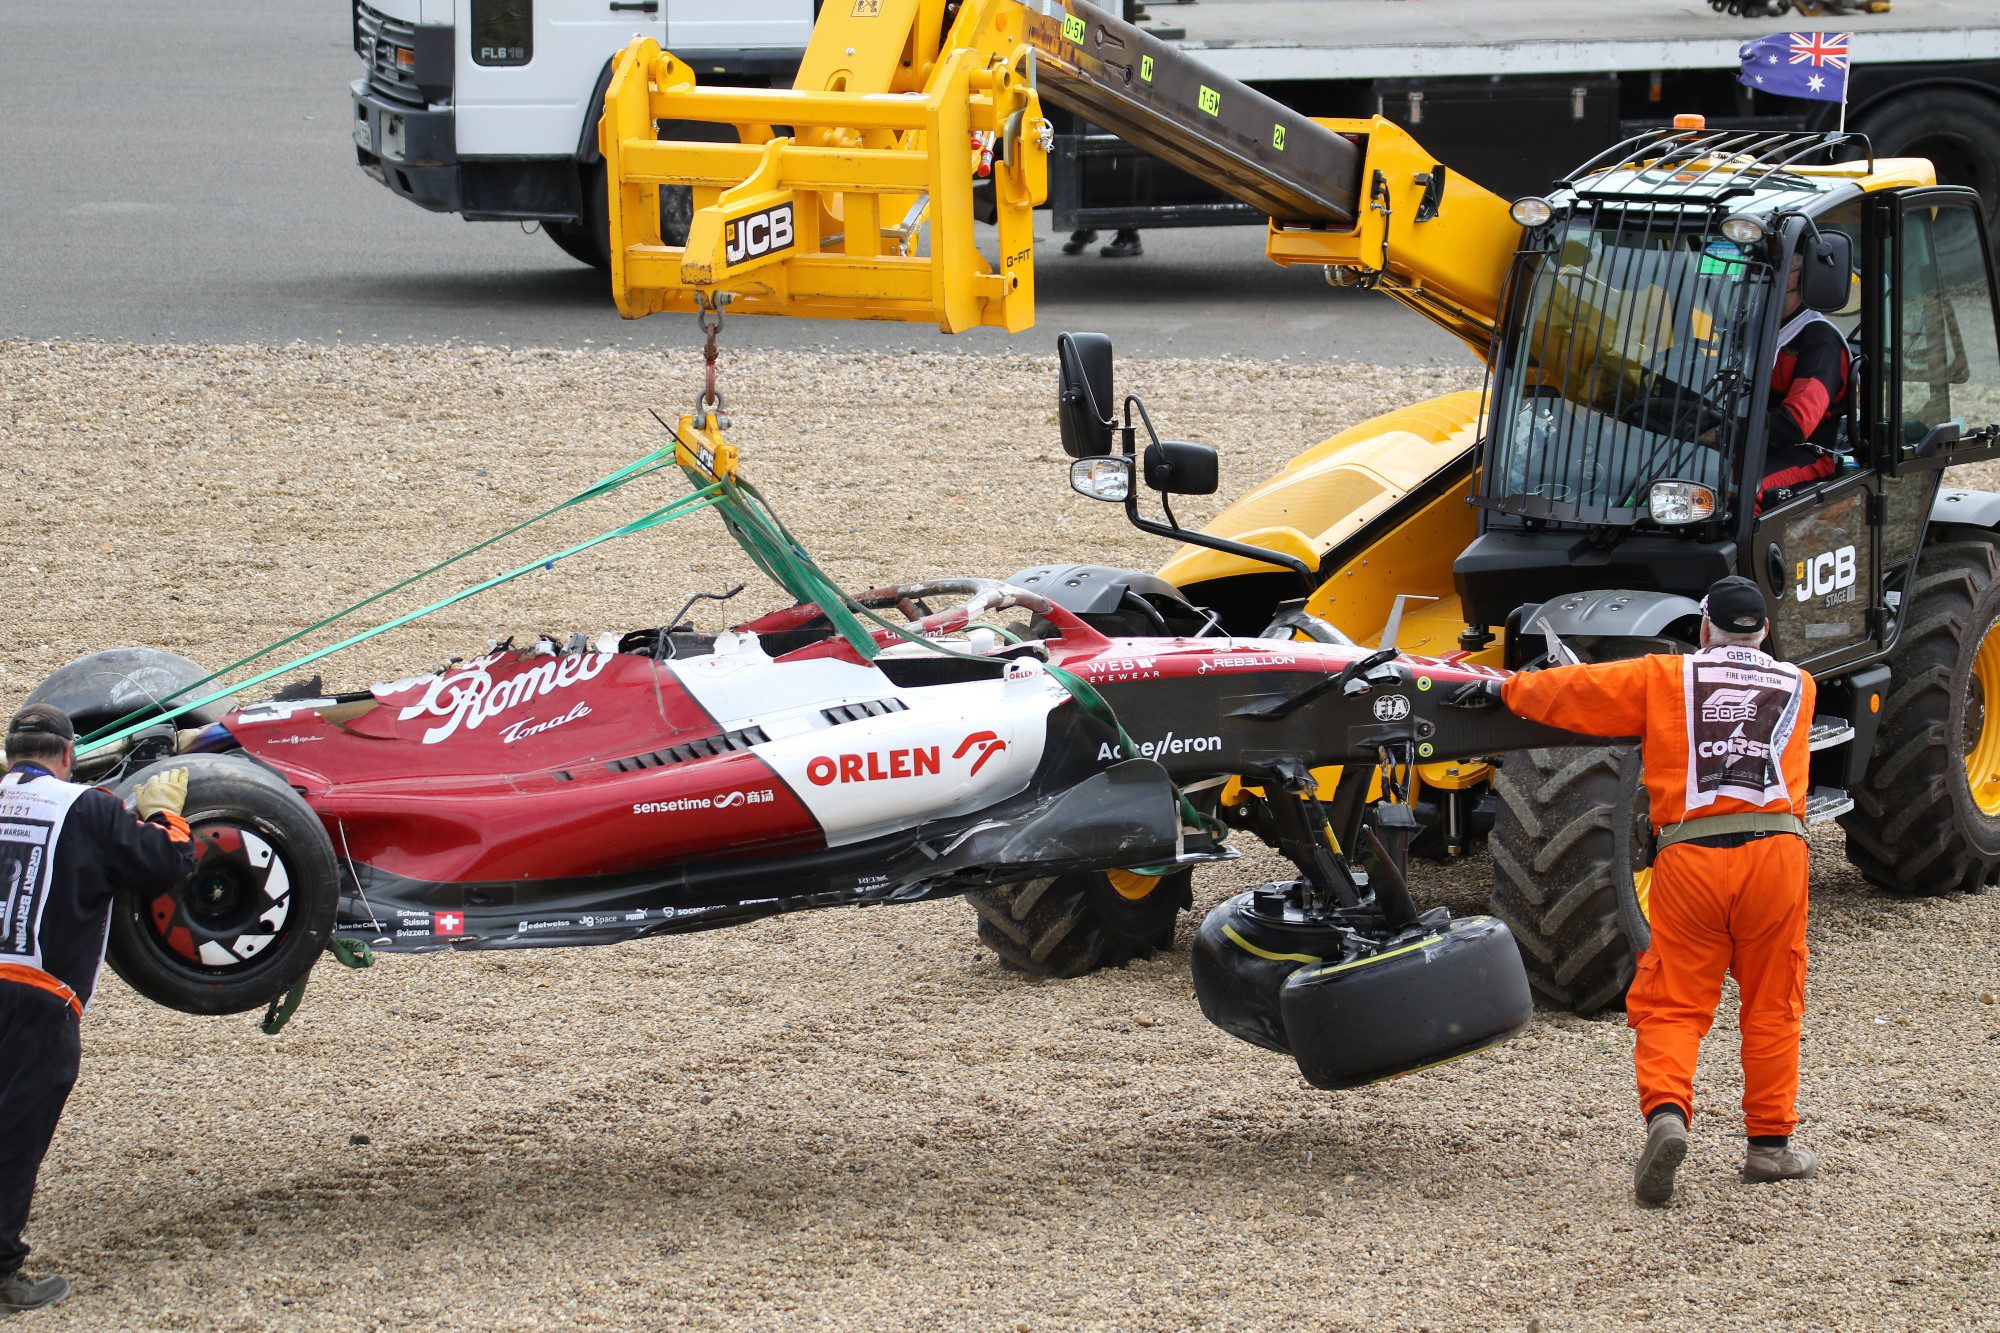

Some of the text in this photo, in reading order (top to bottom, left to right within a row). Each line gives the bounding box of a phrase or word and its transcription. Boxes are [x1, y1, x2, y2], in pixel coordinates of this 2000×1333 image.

[727, 206, 793, 262] JCB
[1006, 248, 1031, 268] G-FIT
[1796, 544, 1856, 602] JCB
[1826, 590, 1847, 608] STAGE
[1087, 659, 1135, 674] WEB
[1726, 651, 1772, 667] GBR137
[1009, 671, 1033, 681] ORLEN
[1090, 670, 1160, 683] EYEWEAR
[1726, 671, 1782, 686] FIRE VEHICLE TEAM
[421, 652, 614, 744] Romeo
[1701, 703, 1758, 722] 2022
[499, 701, 593, 744] Tonale
[806, 745, 941, 787] ORLEN
[0, 803, 31, 816] 1121
[633, 797, 711, 814] sensetime
[3, 828, 31, 838] MARSHAL
[396, 909, 430, 917] Schweiz
[15, 895, 33, 953] BRITAIN
[403, 918, 430, 927] Suisse
[527, 920, 571, 930] edelweiss
[396, 928, 430, 937] Svizzera
